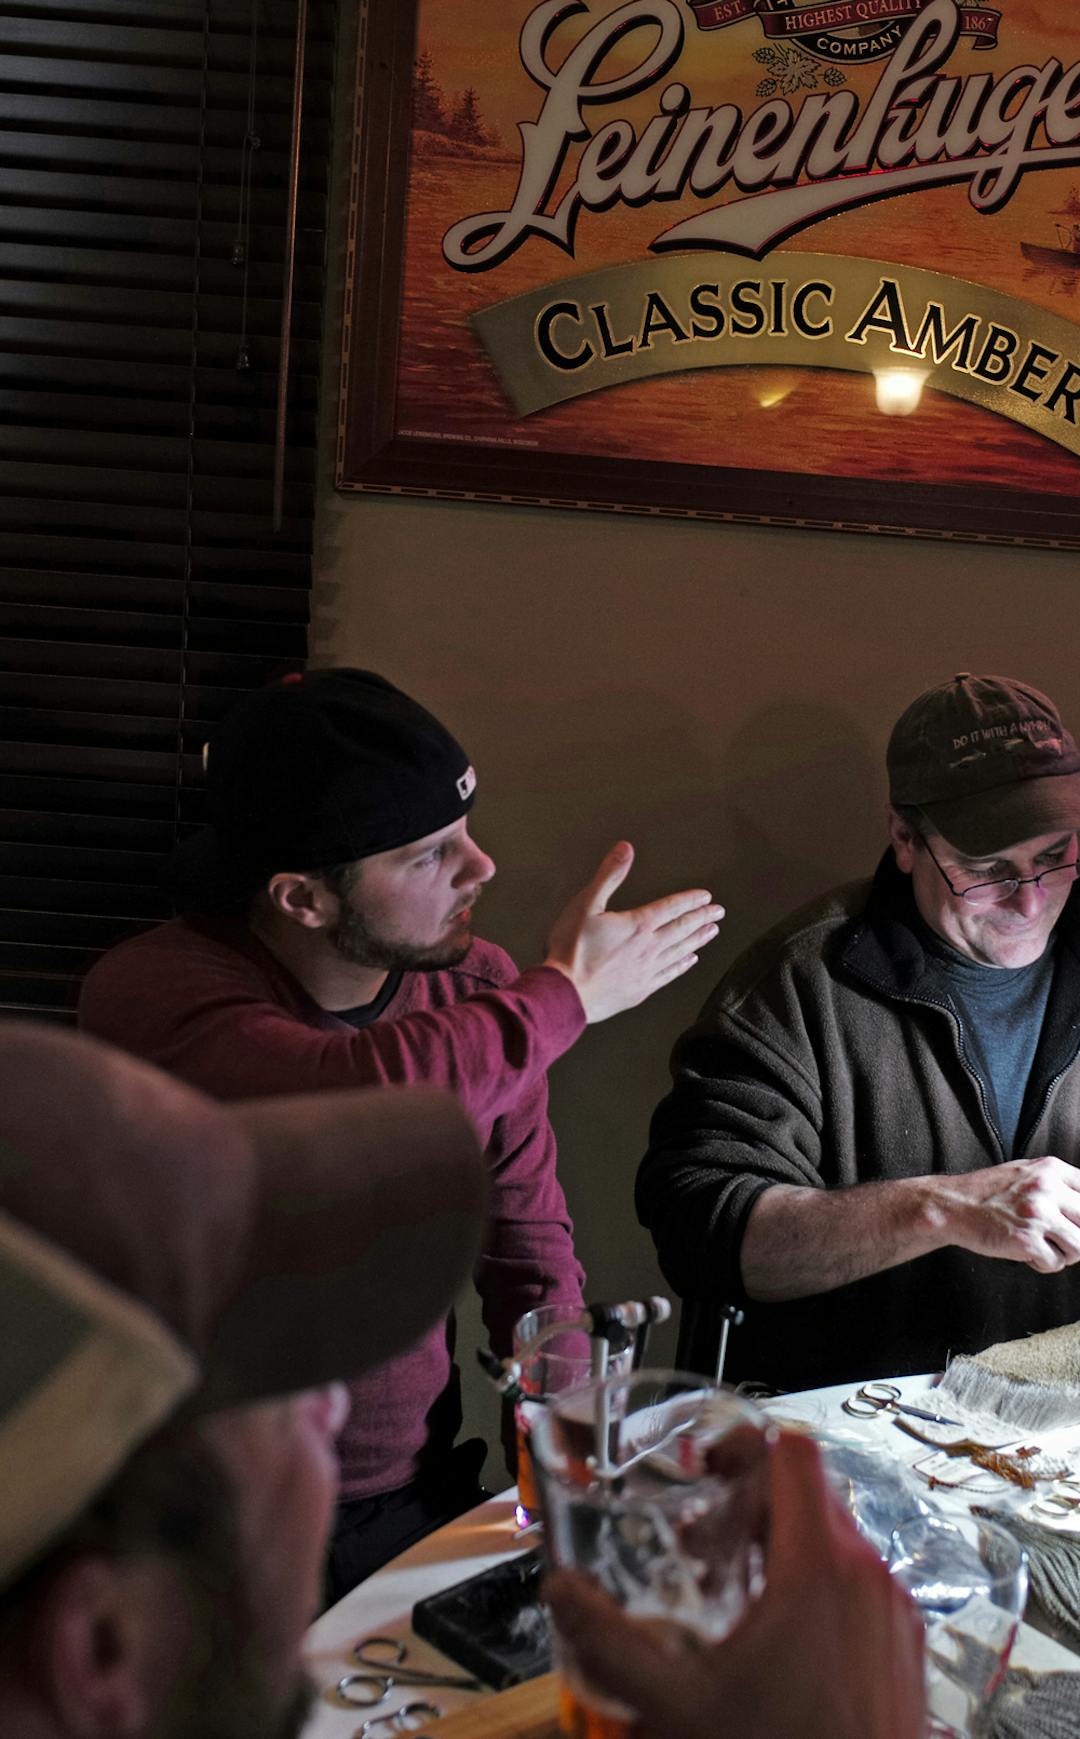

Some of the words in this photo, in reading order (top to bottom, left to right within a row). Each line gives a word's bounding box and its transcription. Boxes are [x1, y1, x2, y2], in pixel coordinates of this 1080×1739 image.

[713, 0, 747, 20] EST.
[785, 4, 852, 31] HIGHEST
[855, 0, 923, 19] QUALITY
[816, 25, 903, 56] COMPANY
[536, 280, 833, 371] CLASSIC
[953, 735, 969, 750] DO
[970, 730, 980, 743] IT
[981, 725, 1009, 740] WITH
